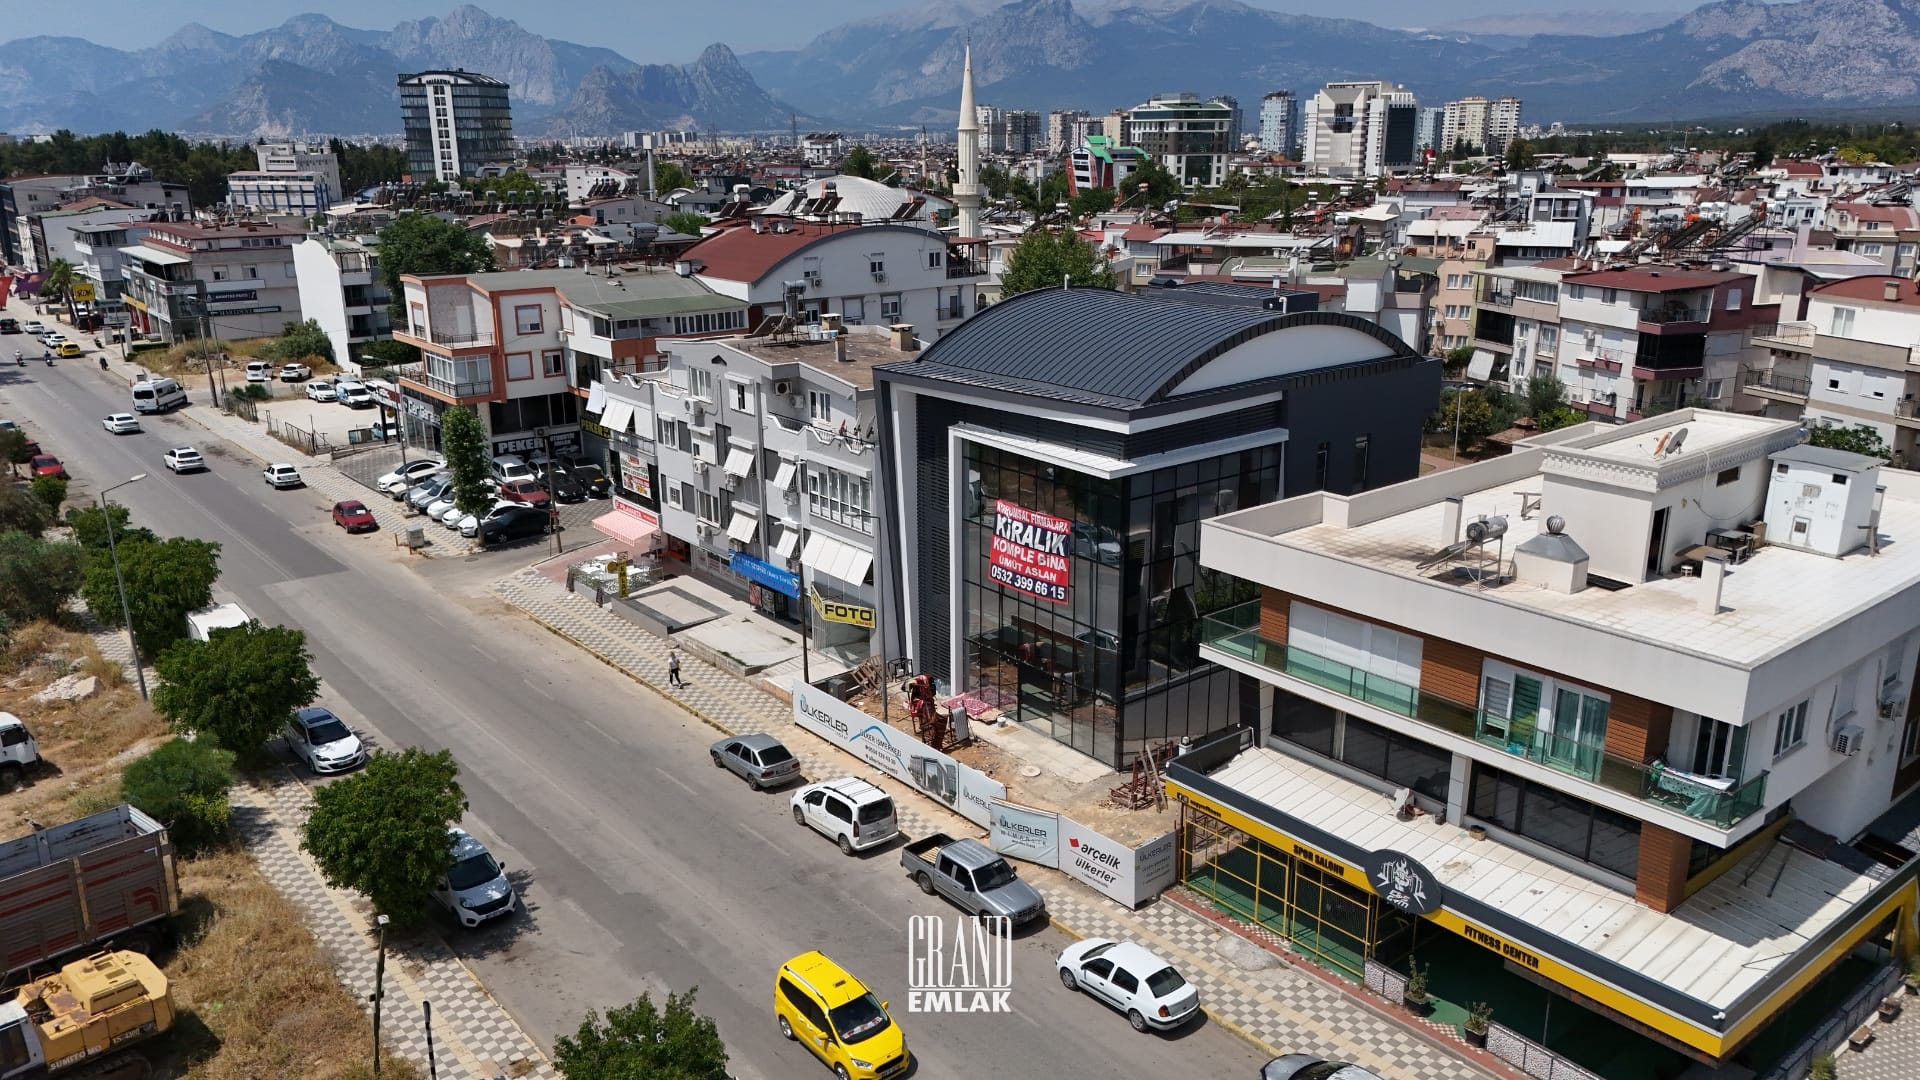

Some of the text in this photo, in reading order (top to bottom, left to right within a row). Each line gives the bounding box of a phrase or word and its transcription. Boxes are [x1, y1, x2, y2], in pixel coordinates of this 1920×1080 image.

[497, 437, 544, 454] PEKER
[996, 501, 1030, 522] KURUMSAL
[993, 537, 1034, 564] KOMPLE
[991, 565, 1065, 600] 0532 399 66 15
[1025, 566, 1057, 582] ASLAN
[824, 604, 873, 621] FOTO
[1000, 815, 1047, 838] ÜLKERLER
[1081, 843, 1121, 870] arçelik
[1293, 844, 1345, 876] SPOR SALONU
[1075, 857, 1117, 884] ülkerler
[1464, 924, 1539, 969] FITNESS CENTER
